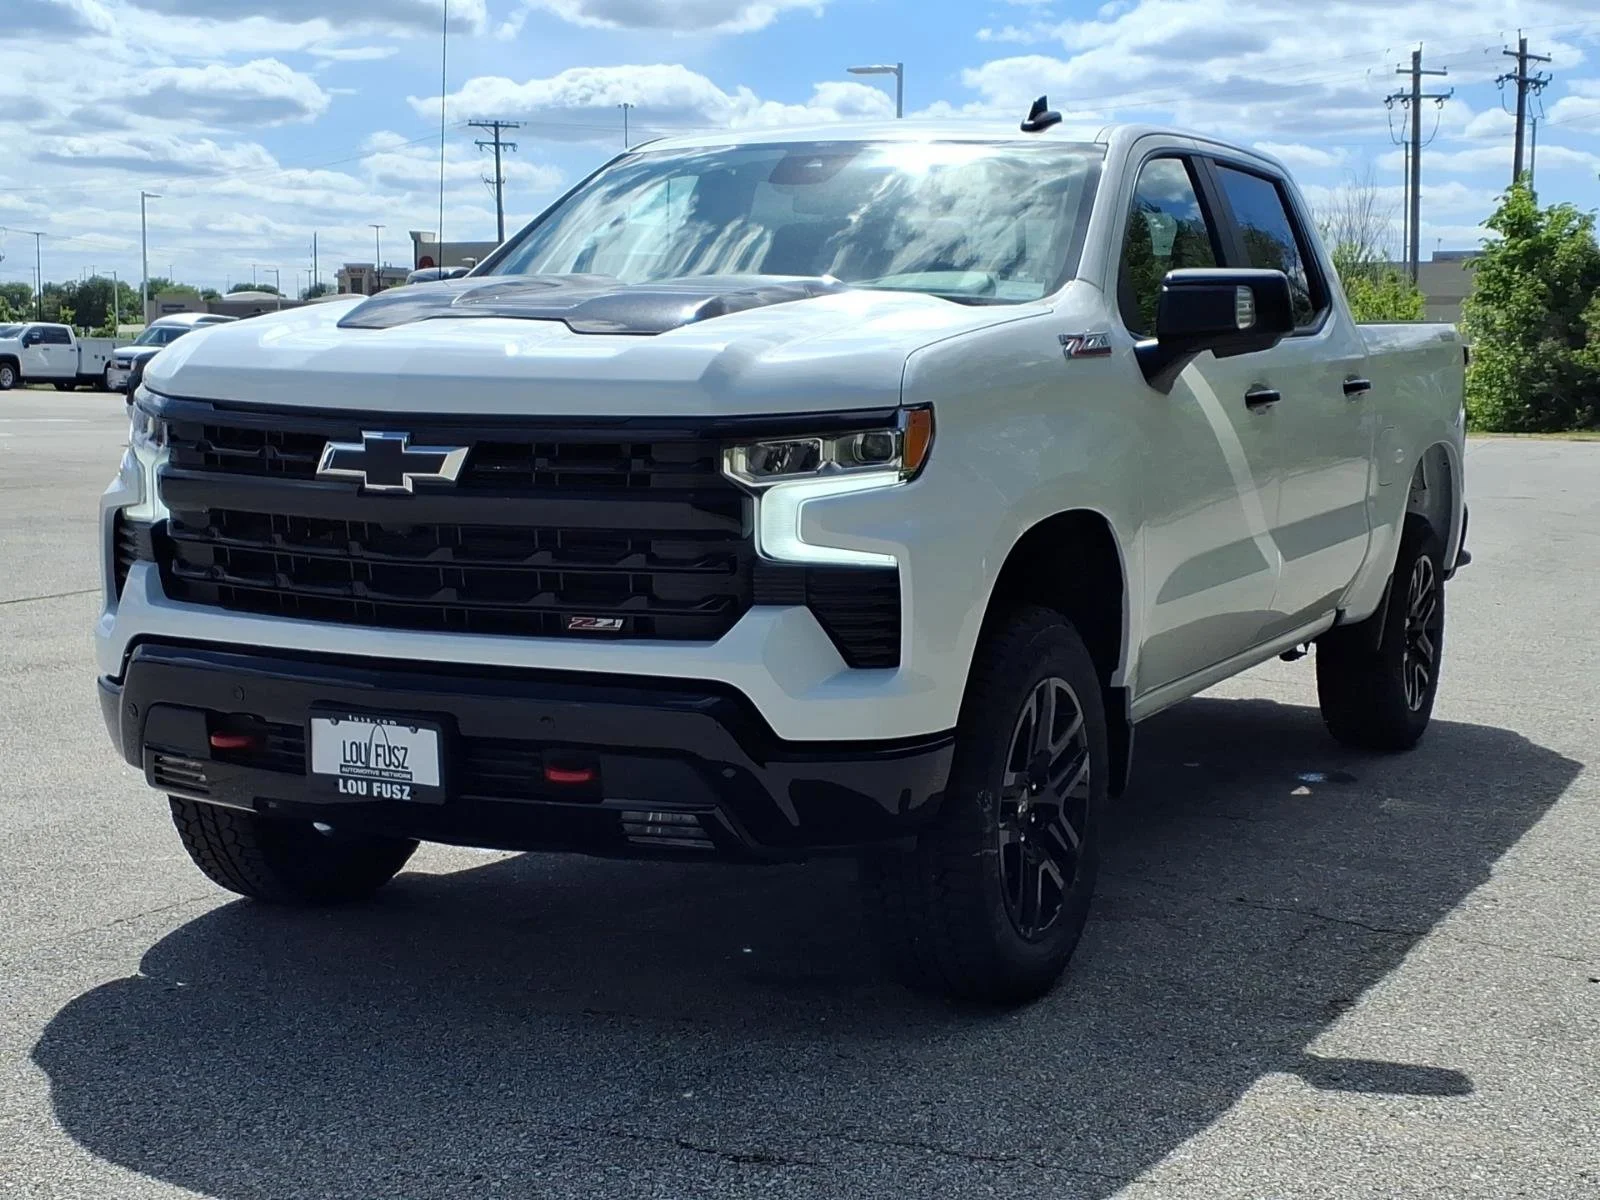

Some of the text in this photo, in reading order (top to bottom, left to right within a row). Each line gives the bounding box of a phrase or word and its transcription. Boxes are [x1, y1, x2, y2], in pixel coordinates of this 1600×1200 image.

[568, 617, 623, 630] Z71
[342, 740, 409, 769] LOU FUSZ
[341, 766, 412, 779] AUTOMOTIVE NETWORK
[339, 778, 411, 800] LOU FUSZ
